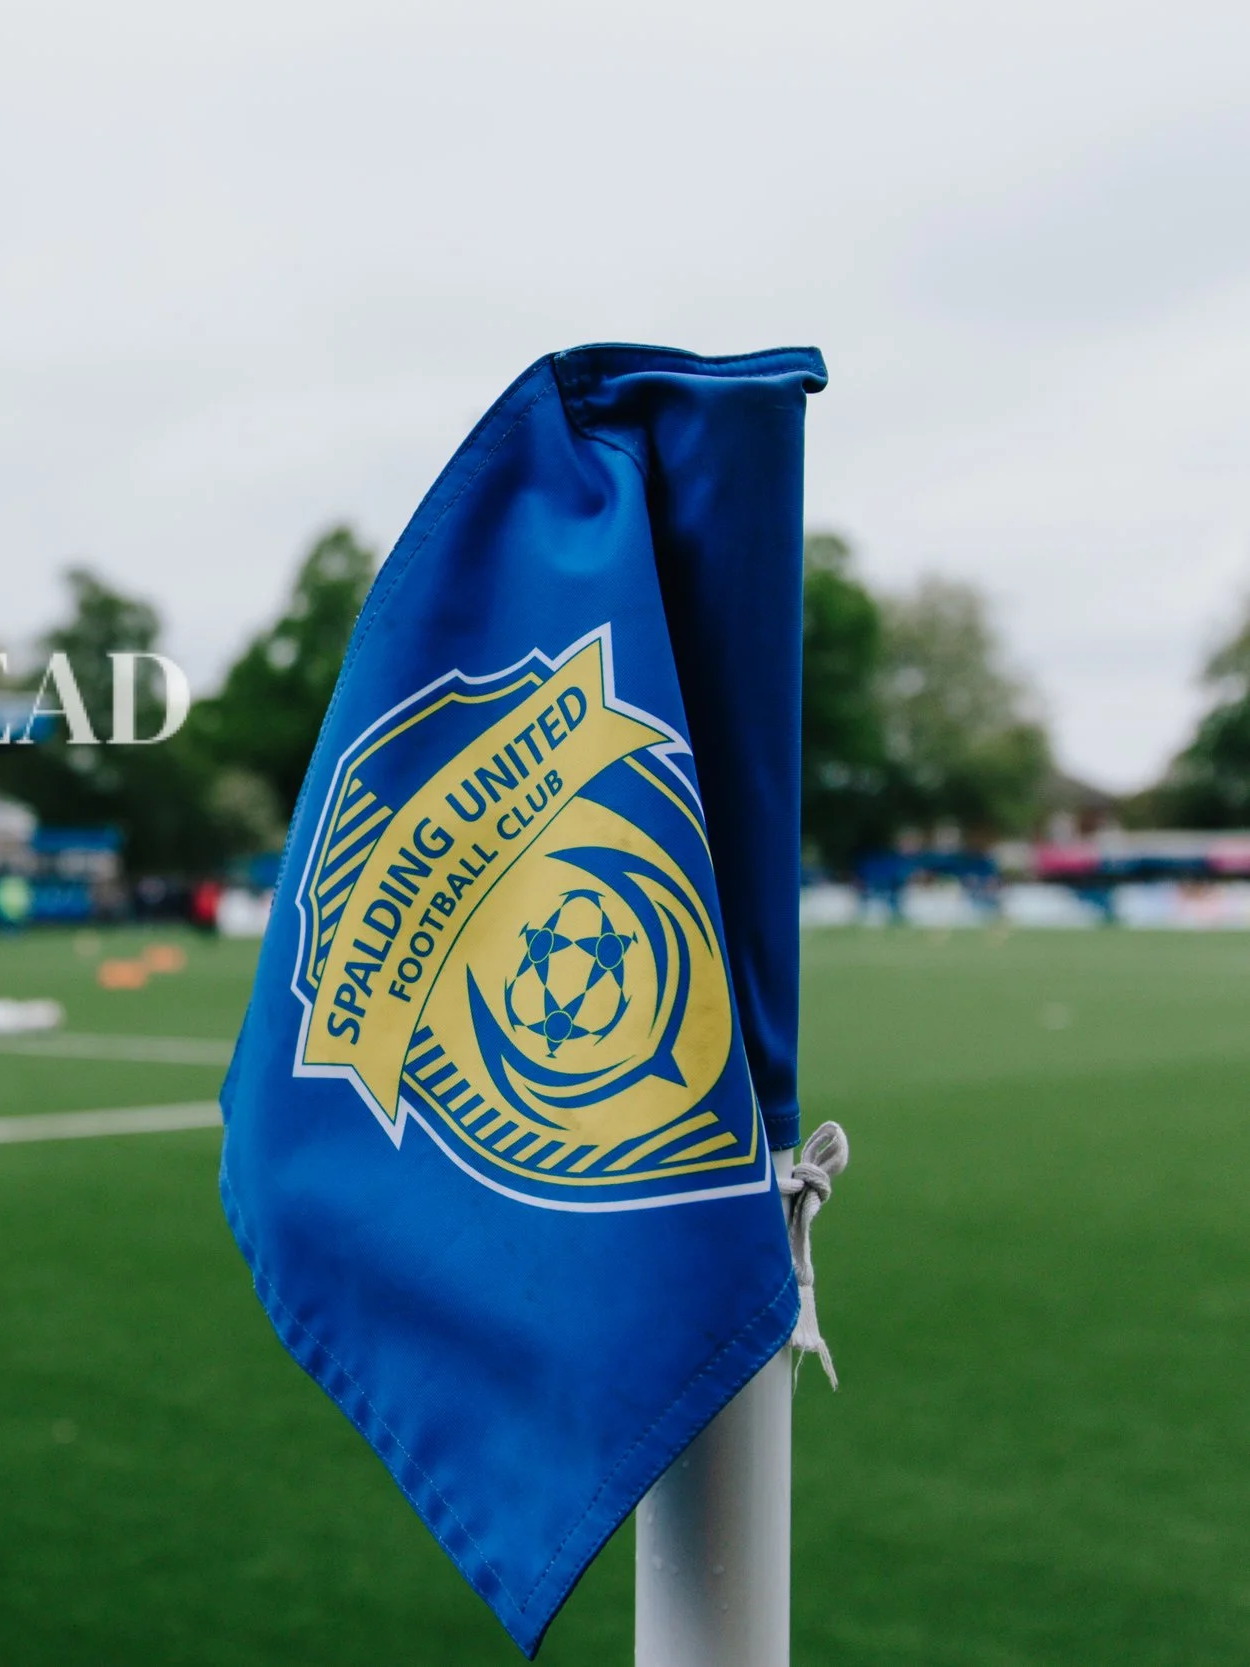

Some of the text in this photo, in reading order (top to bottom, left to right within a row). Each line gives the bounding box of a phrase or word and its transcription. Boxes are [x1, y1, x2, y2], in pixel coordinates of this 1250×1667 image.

[326, 685, 588, 1046] SPALDING UNITED
[388, 768, 565, 1003] FOOTBALL CLUB
